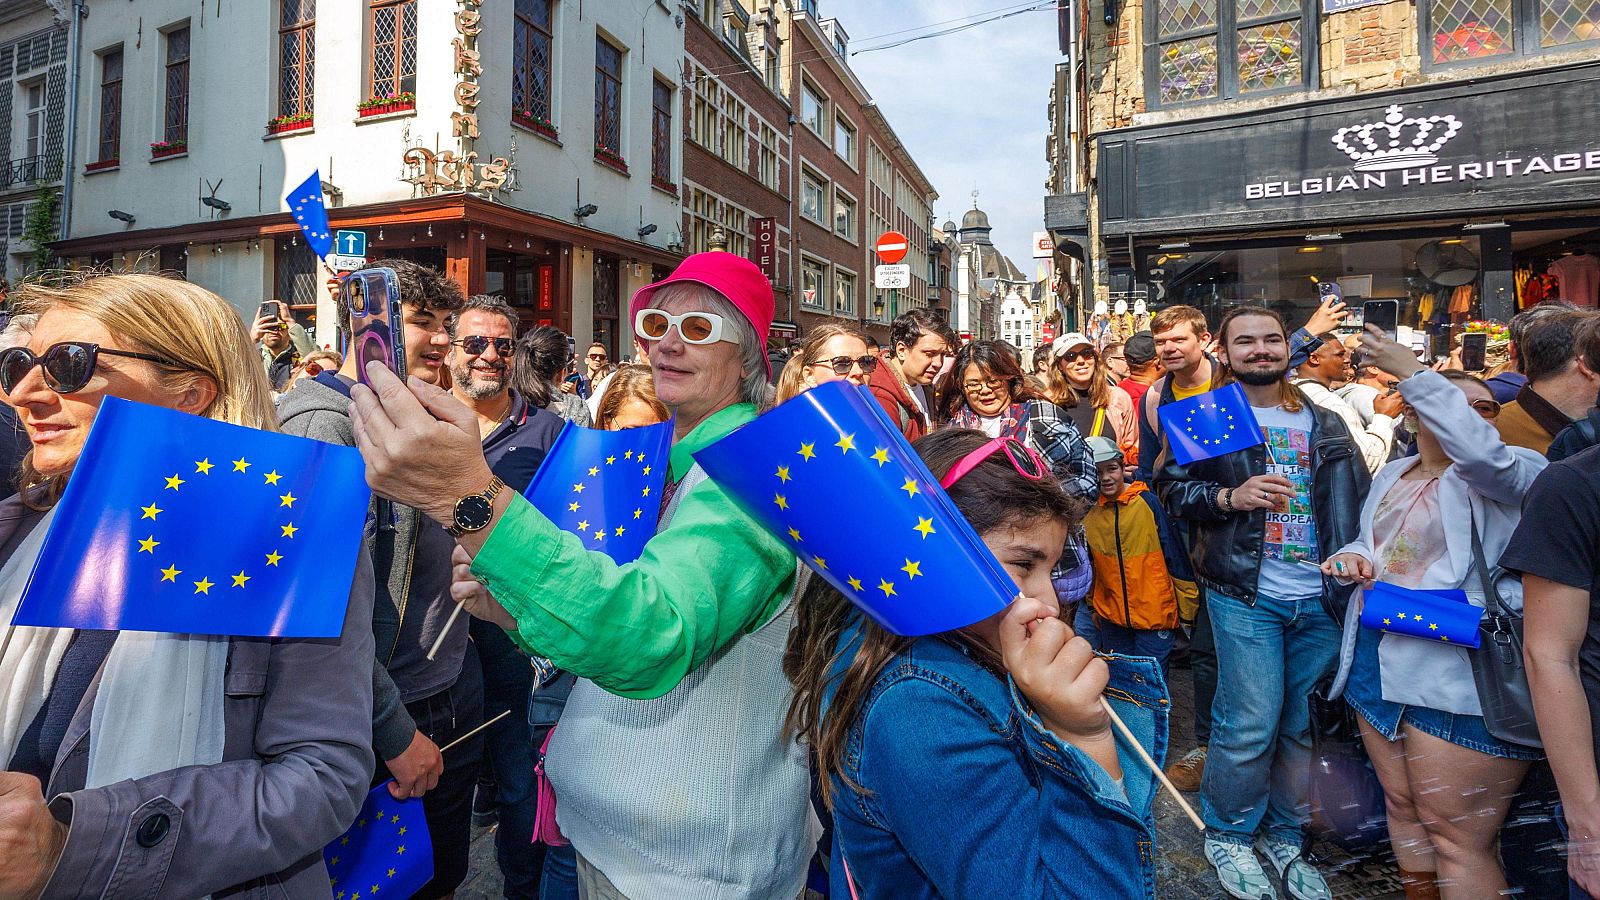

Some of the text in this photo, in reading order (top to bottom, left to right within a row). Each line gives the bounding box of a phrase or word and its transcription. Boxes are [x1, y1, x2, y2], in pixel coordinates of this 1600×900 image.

[451, 0, 483, 139] eken
[1245, 151, 1600, 200] BELGIAN HERITAGE
[760, 220, 770, 277] HOTEL
